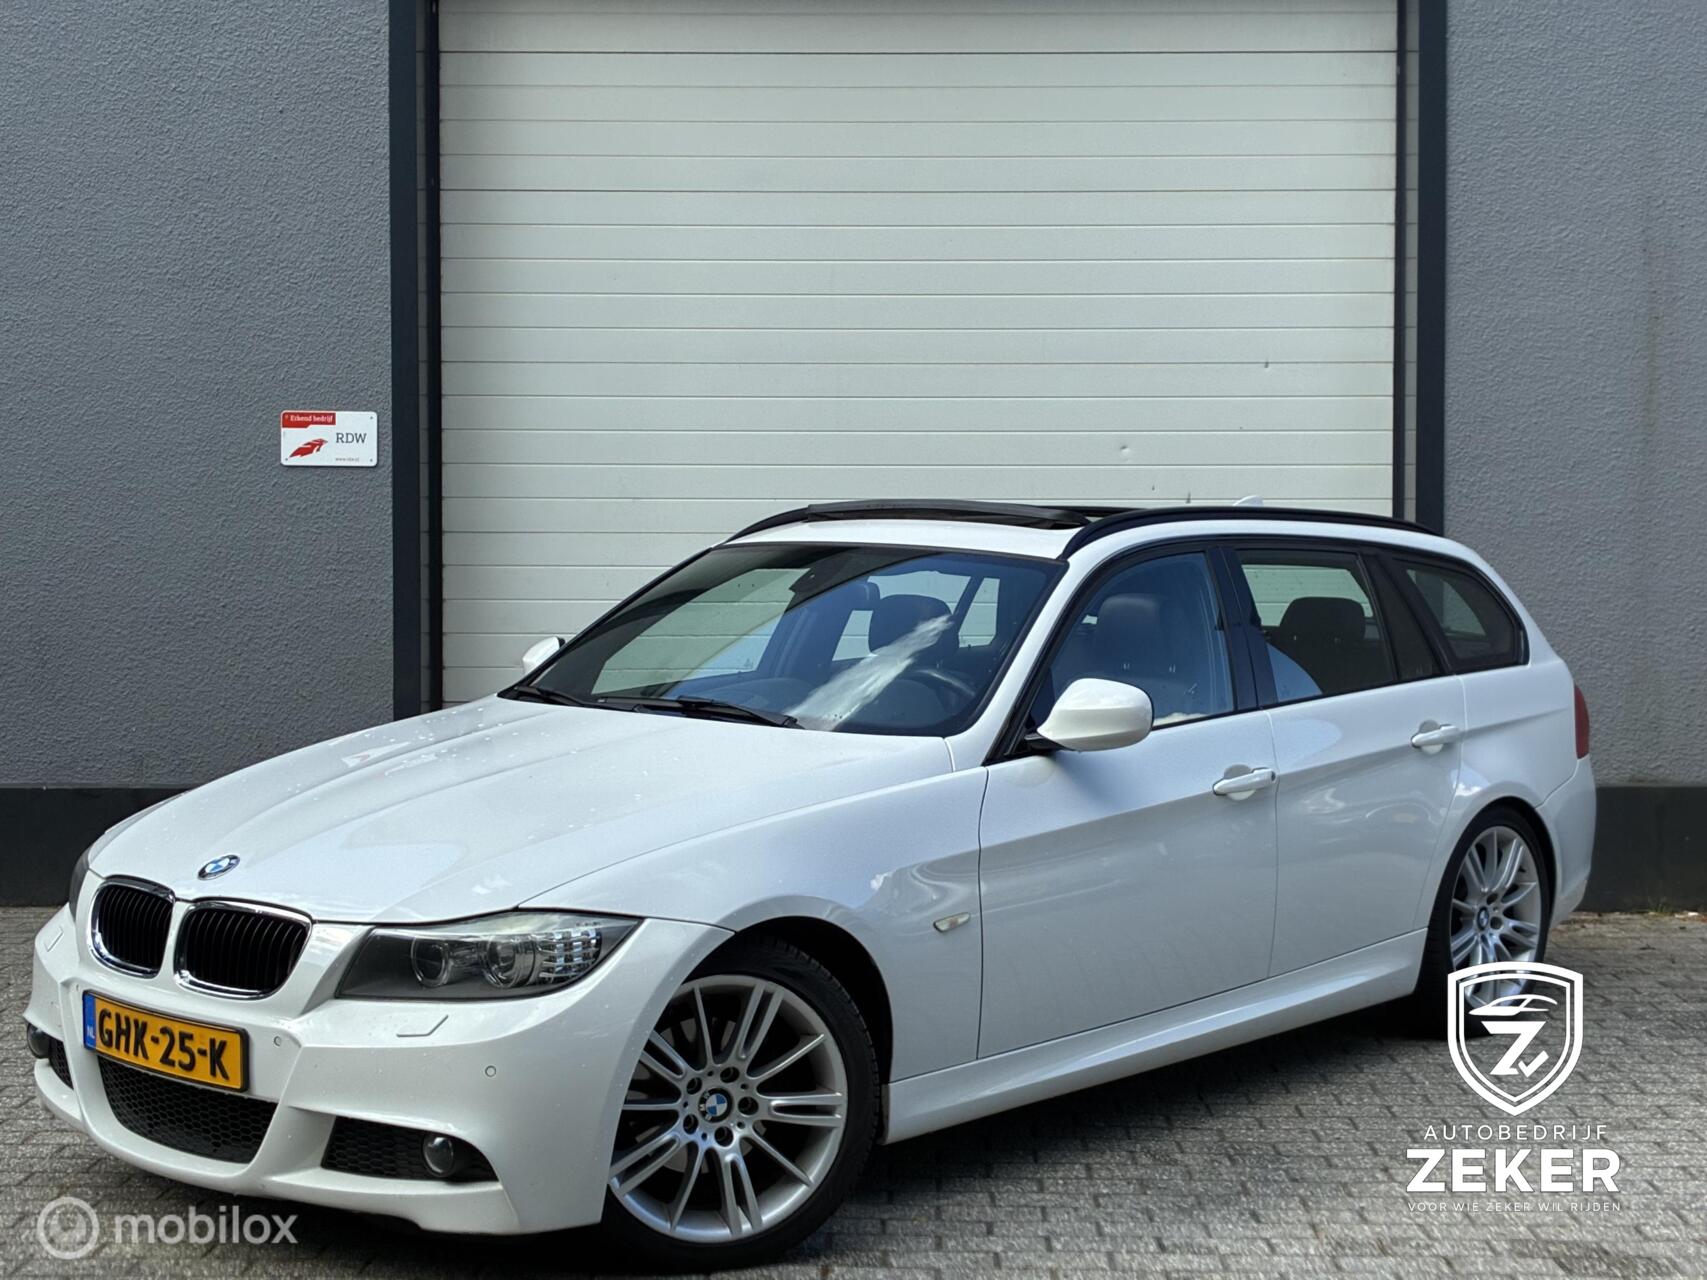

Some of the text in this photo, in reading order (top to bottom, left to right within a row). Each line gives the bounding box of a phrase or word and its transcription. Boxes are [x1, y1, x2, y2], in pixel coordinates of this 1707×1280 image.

[290, 414, 333, 423] Erkend bedrijf
[336, 432, 367, 444] RDW
[86, 1025, 95, 1039] NL
[98, 1008, 230, 1081] GHK-25-K
